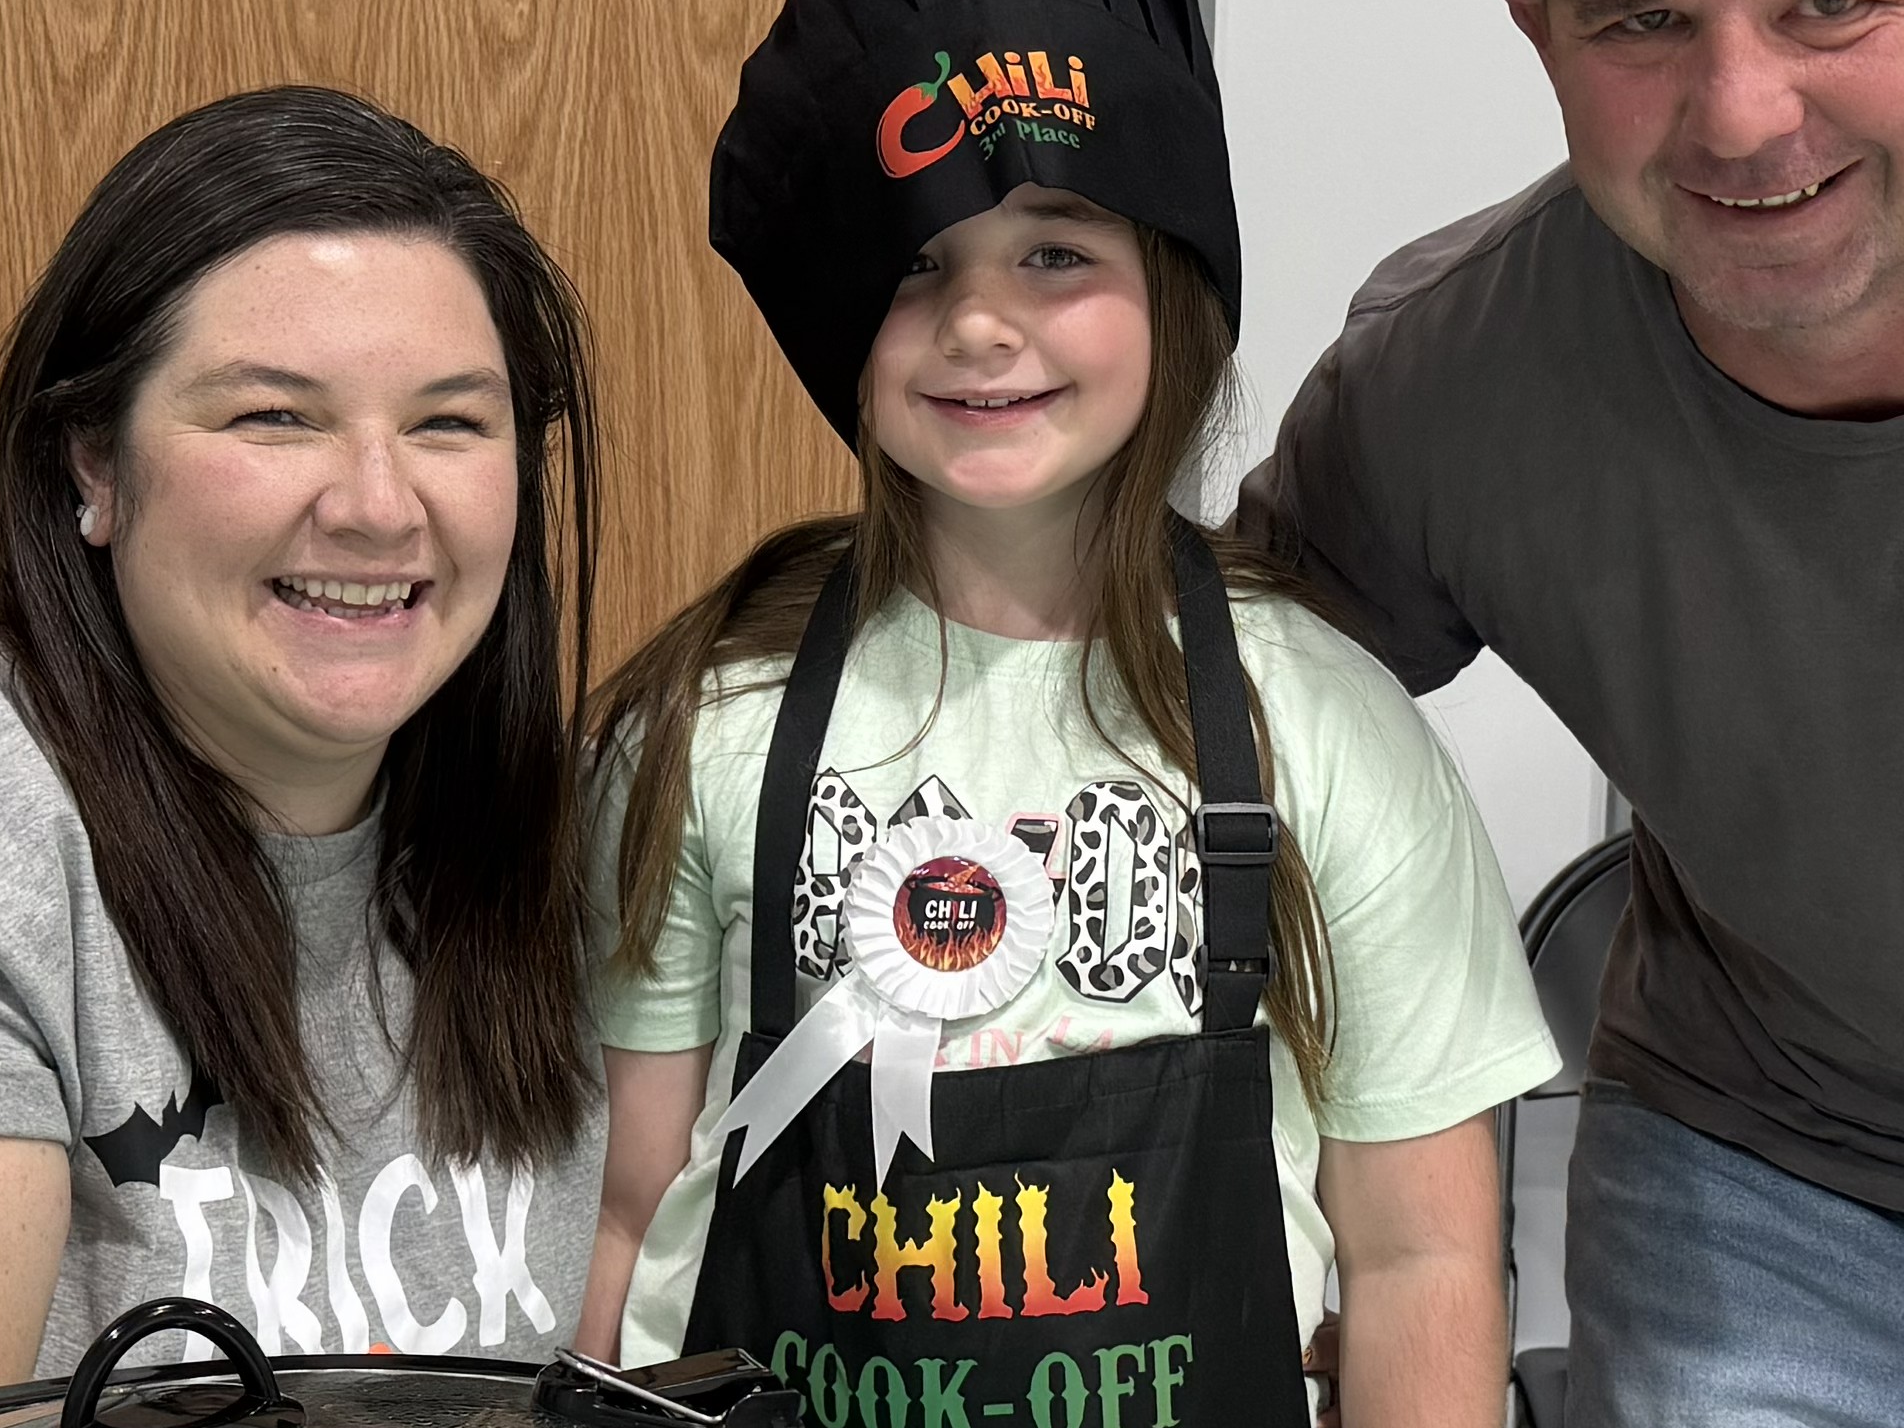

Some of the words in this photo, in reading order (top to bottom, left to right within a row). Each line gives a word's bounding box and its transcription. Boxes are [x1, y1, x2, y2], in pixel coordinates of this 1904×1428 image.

[969, 98, 1096, 136] COOK-OFF
[1012, 117, 1081, 149] Place
[923, 920, 950, 931] COOK
[956, 920, 975, 931] OFF
[159, 1153, 557, 1363] TRICK
[821, 1168, 1150, 1323] CHILI
